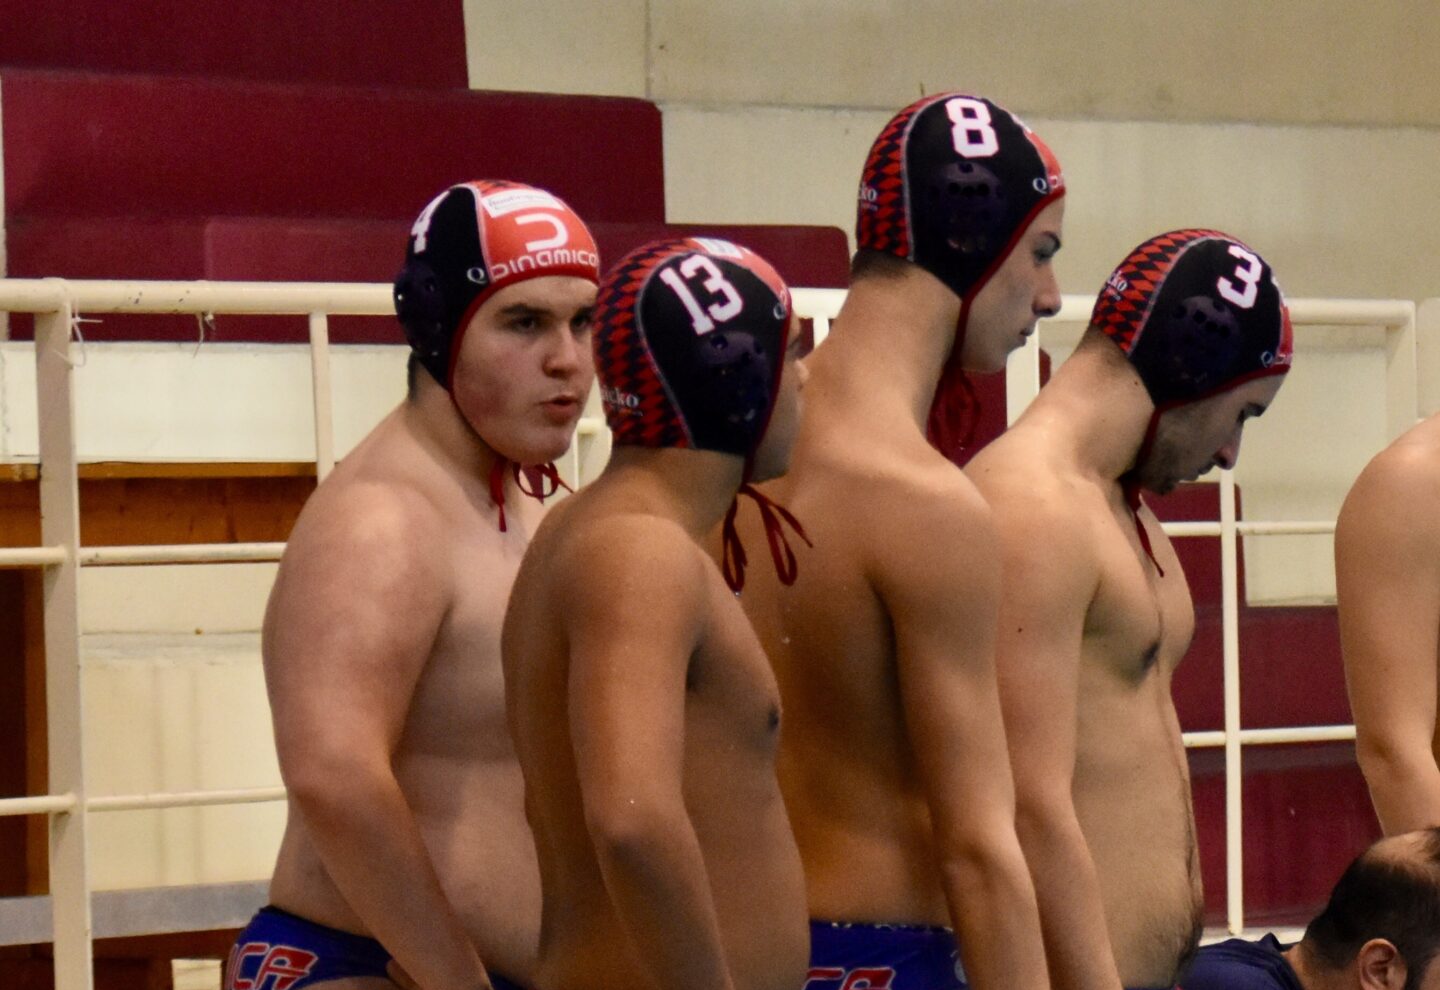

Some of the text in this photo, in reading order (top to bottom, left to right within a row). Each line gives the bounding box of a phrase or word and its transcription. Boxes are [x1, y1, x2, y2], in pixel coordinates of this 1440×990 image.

[945, 97, 999, 159] 8
[411, 190, 449, 254] 4
[659, 253, 744, 336] 13
[1217, 244, 1263, 310] 3
